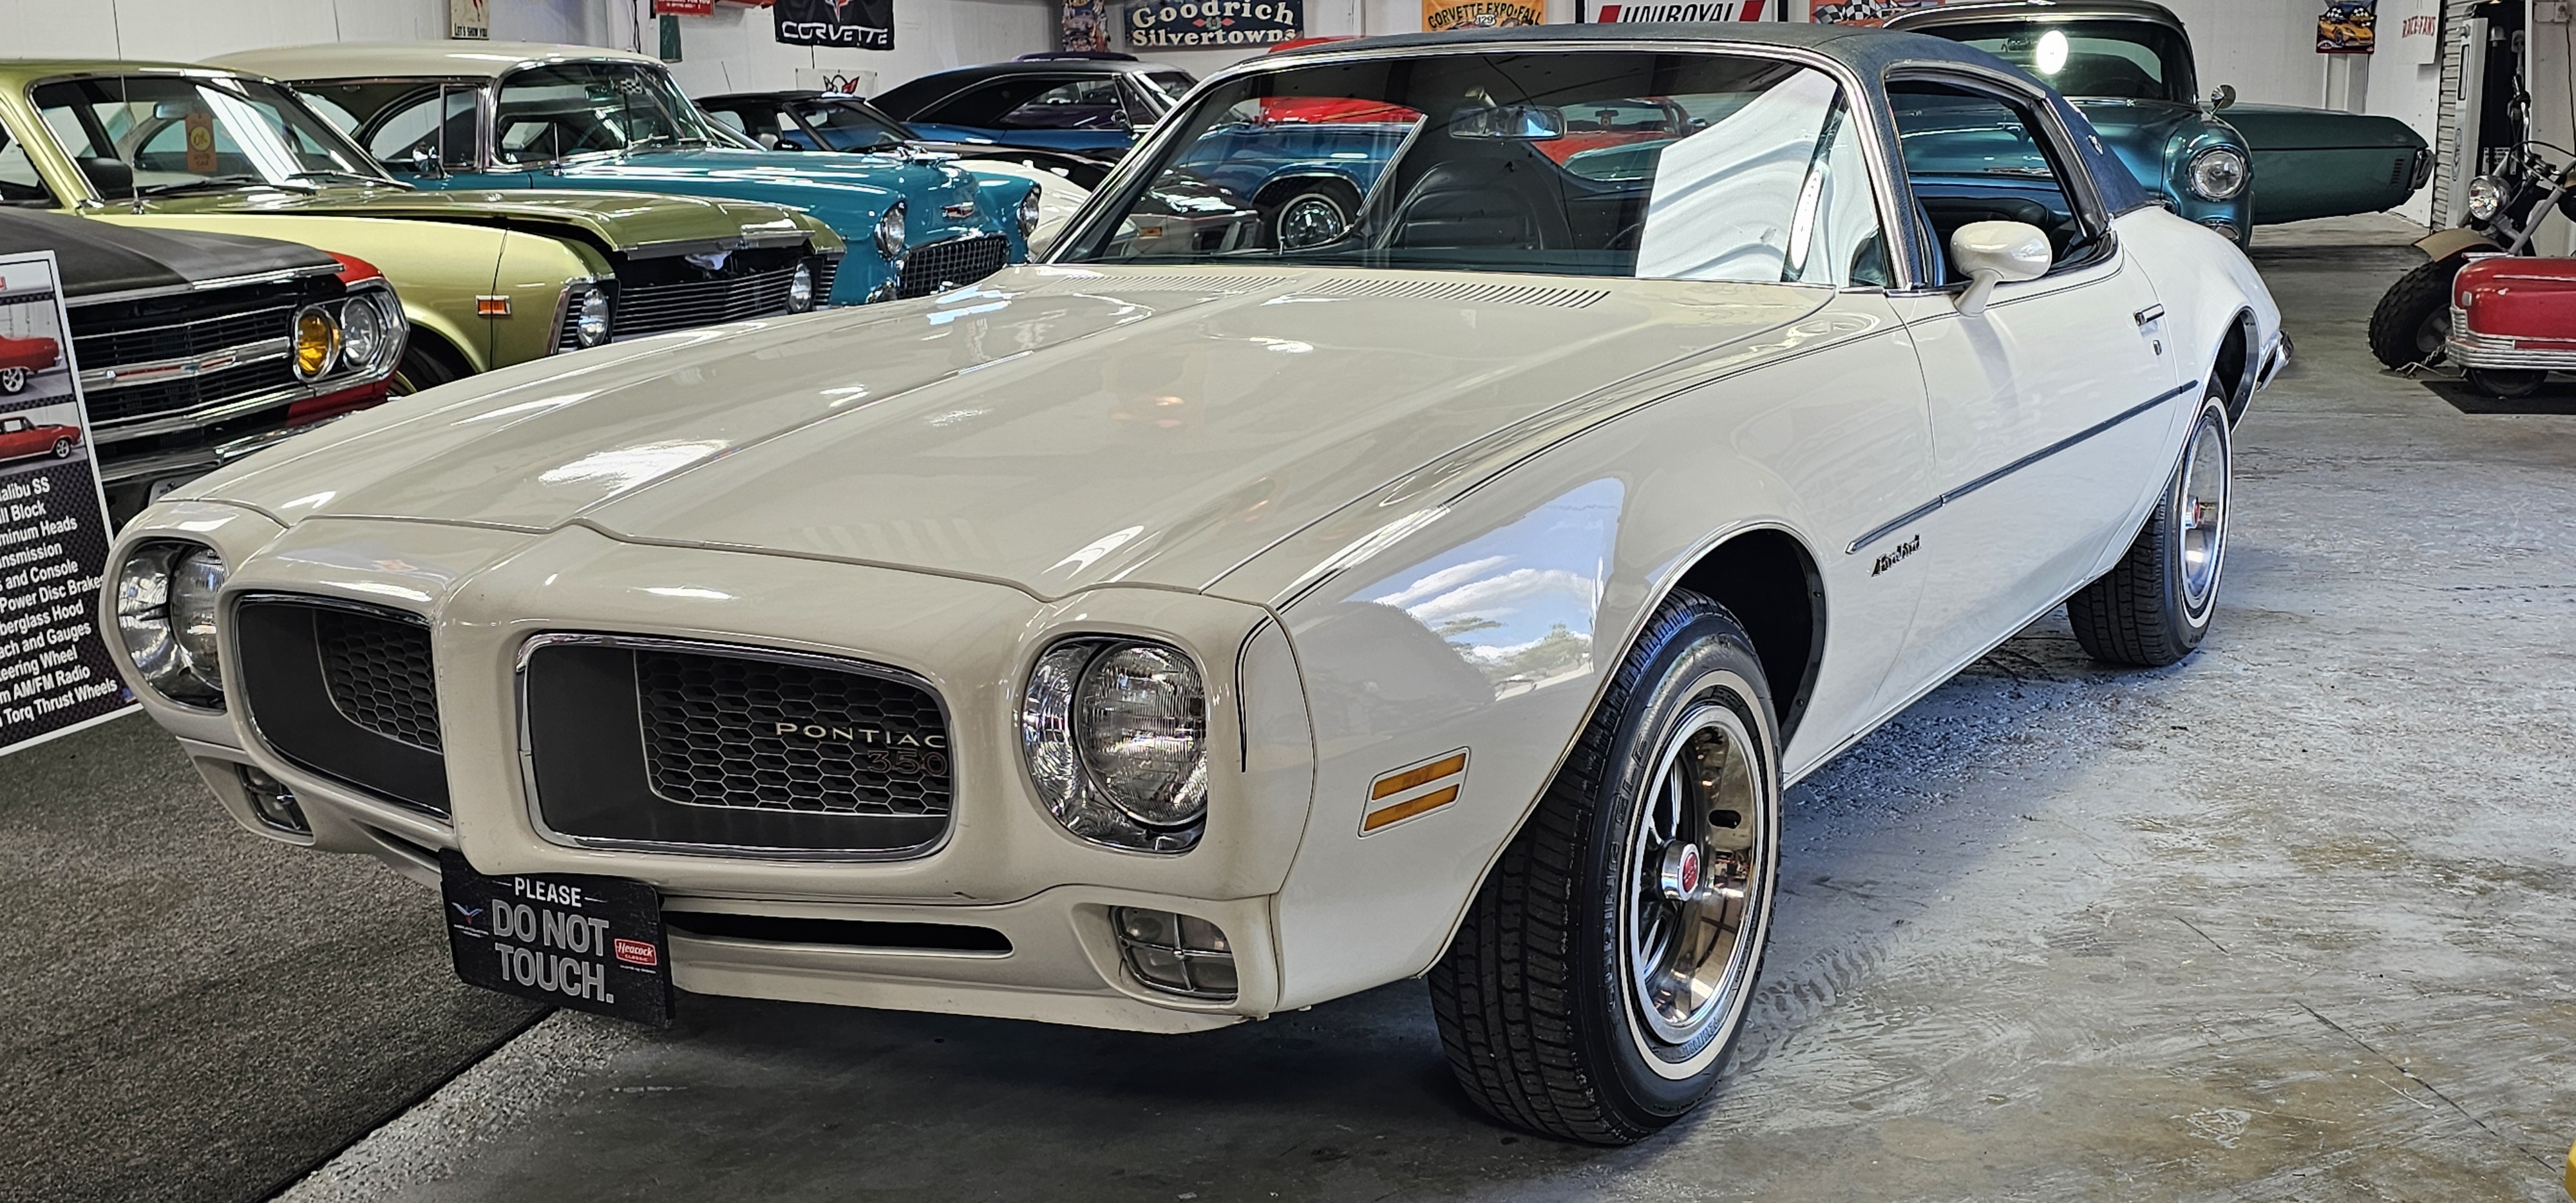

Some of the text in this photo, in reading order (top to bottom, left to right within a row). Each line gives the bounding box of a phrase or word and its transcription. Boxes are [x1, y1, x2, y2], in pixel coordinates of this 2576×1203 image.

[1132, 0, 1294, 28] Goodrich
[1428, 3, 1483, 29] CORVETTE
[1622, 3, 1734, 23] UNIROYAL
[781, 21, 889, 45] CORVETTE
[1132, 28, 1296, 47] Silvertowns
[0, 476, 51, 502] alibu SS
[10, 499, 47, 522] Block
[40, 515, 78, 537] Heads
[5, 569, 29, 590] and
[30, 558, 79, 583] Console
[0, 592, 37, 614] Power
[39, 585, 67, 603] Disc
[52, 598, 84, 621] Hood
[22, 631, 46, 653] and
[46, 622, 92, 645] Gauges
[39, 643, 79, 670] Wheel
[14, 673, 55, 701] AM/FM
[55, 664, 91, 687] Radio
[3, 705, 35, 725] Torq
[33, 690, 75, 715] Thrust
[74, 677, 118, 703] Wheels
[775, 721, 947, 748] PONTIAC
[867, 750, 948, 777] 350
[515, 876, 582, 907] PLEASE
[491, 898, 609, 957] DO NOT
[616, 942, 654, 958] Heacock
[495, 942, 614, 1004] TOUCH.
